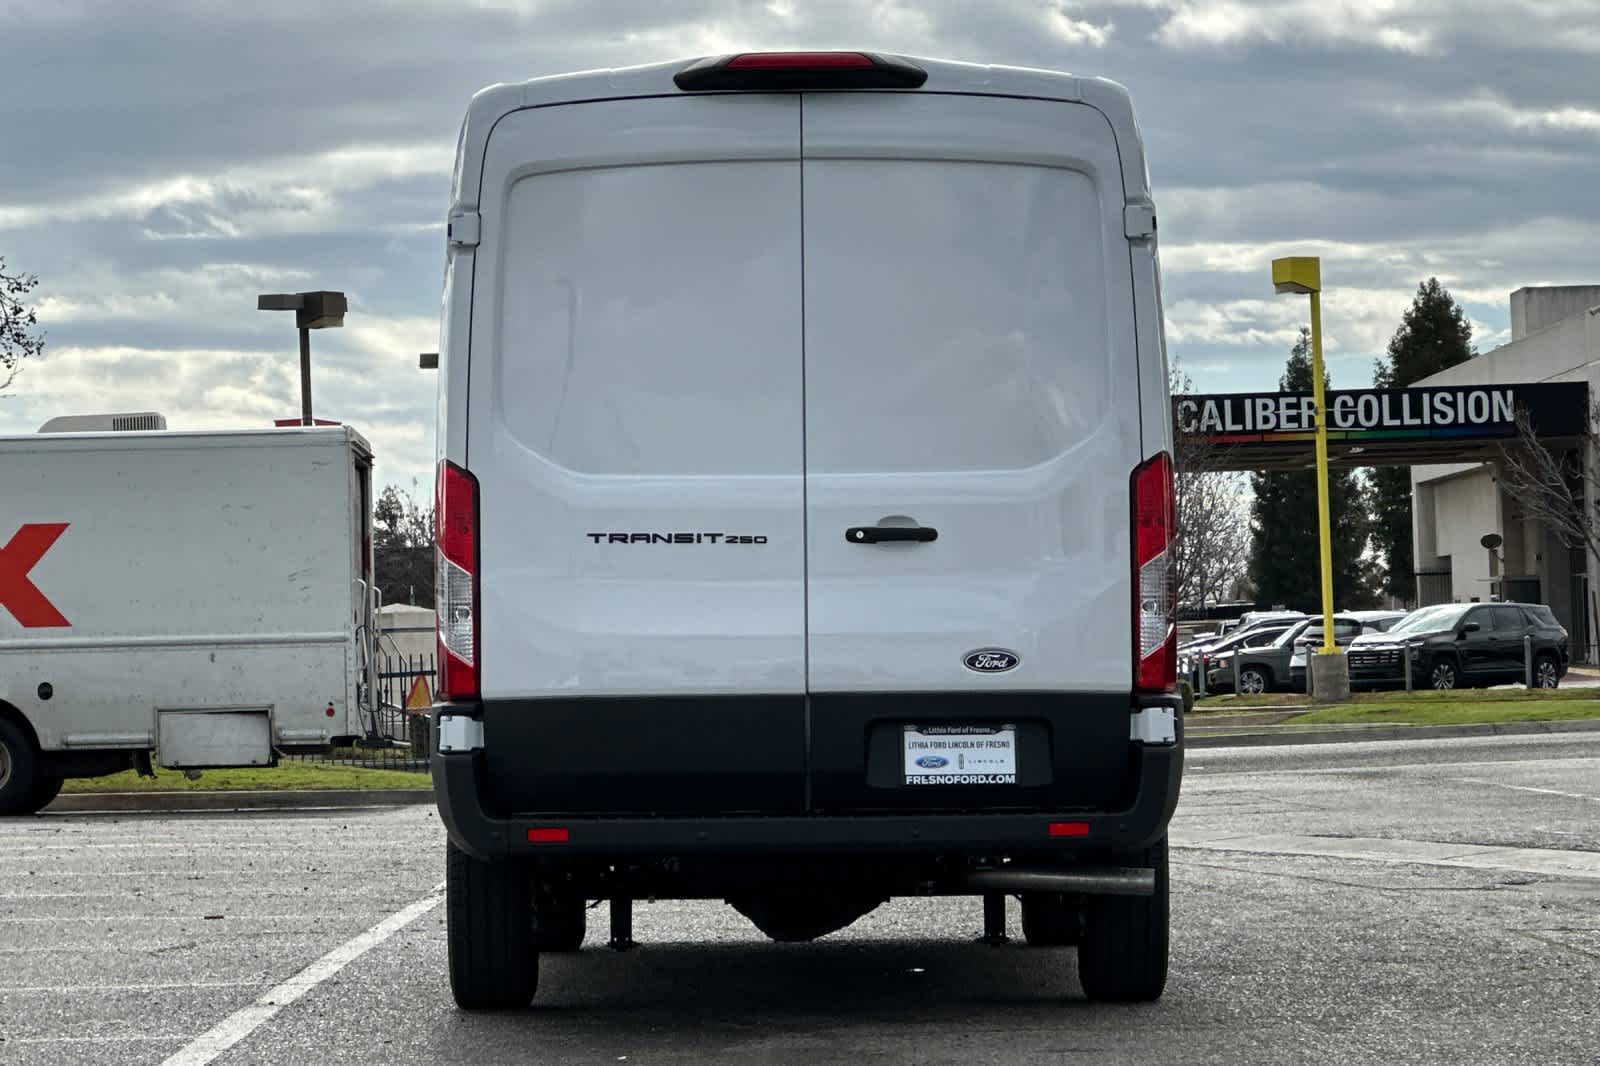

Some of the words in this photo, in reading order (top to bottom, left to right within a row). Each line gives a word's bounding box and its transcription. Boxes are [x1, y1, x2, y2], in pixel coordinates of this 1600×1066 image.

[1177, 397, 1319, 432] CALIBER
[1334, 389, 1515, 427] COLLISION
[587, 533, 724, 544] TRANSIT
[725, 535, 768, 544] 250
[975, 654, 1009, 668] Ford
[908, 741, 929, 749] LITHIA
[930, 741, 947, 749] FORD
[948, 741, 975, 749] LINCOLN
[976, 741, 985, 749] OF
[986, 741, 1010, 749] FRESNO
[906, 775, 1016, 785] FRESNOFORD.COM
